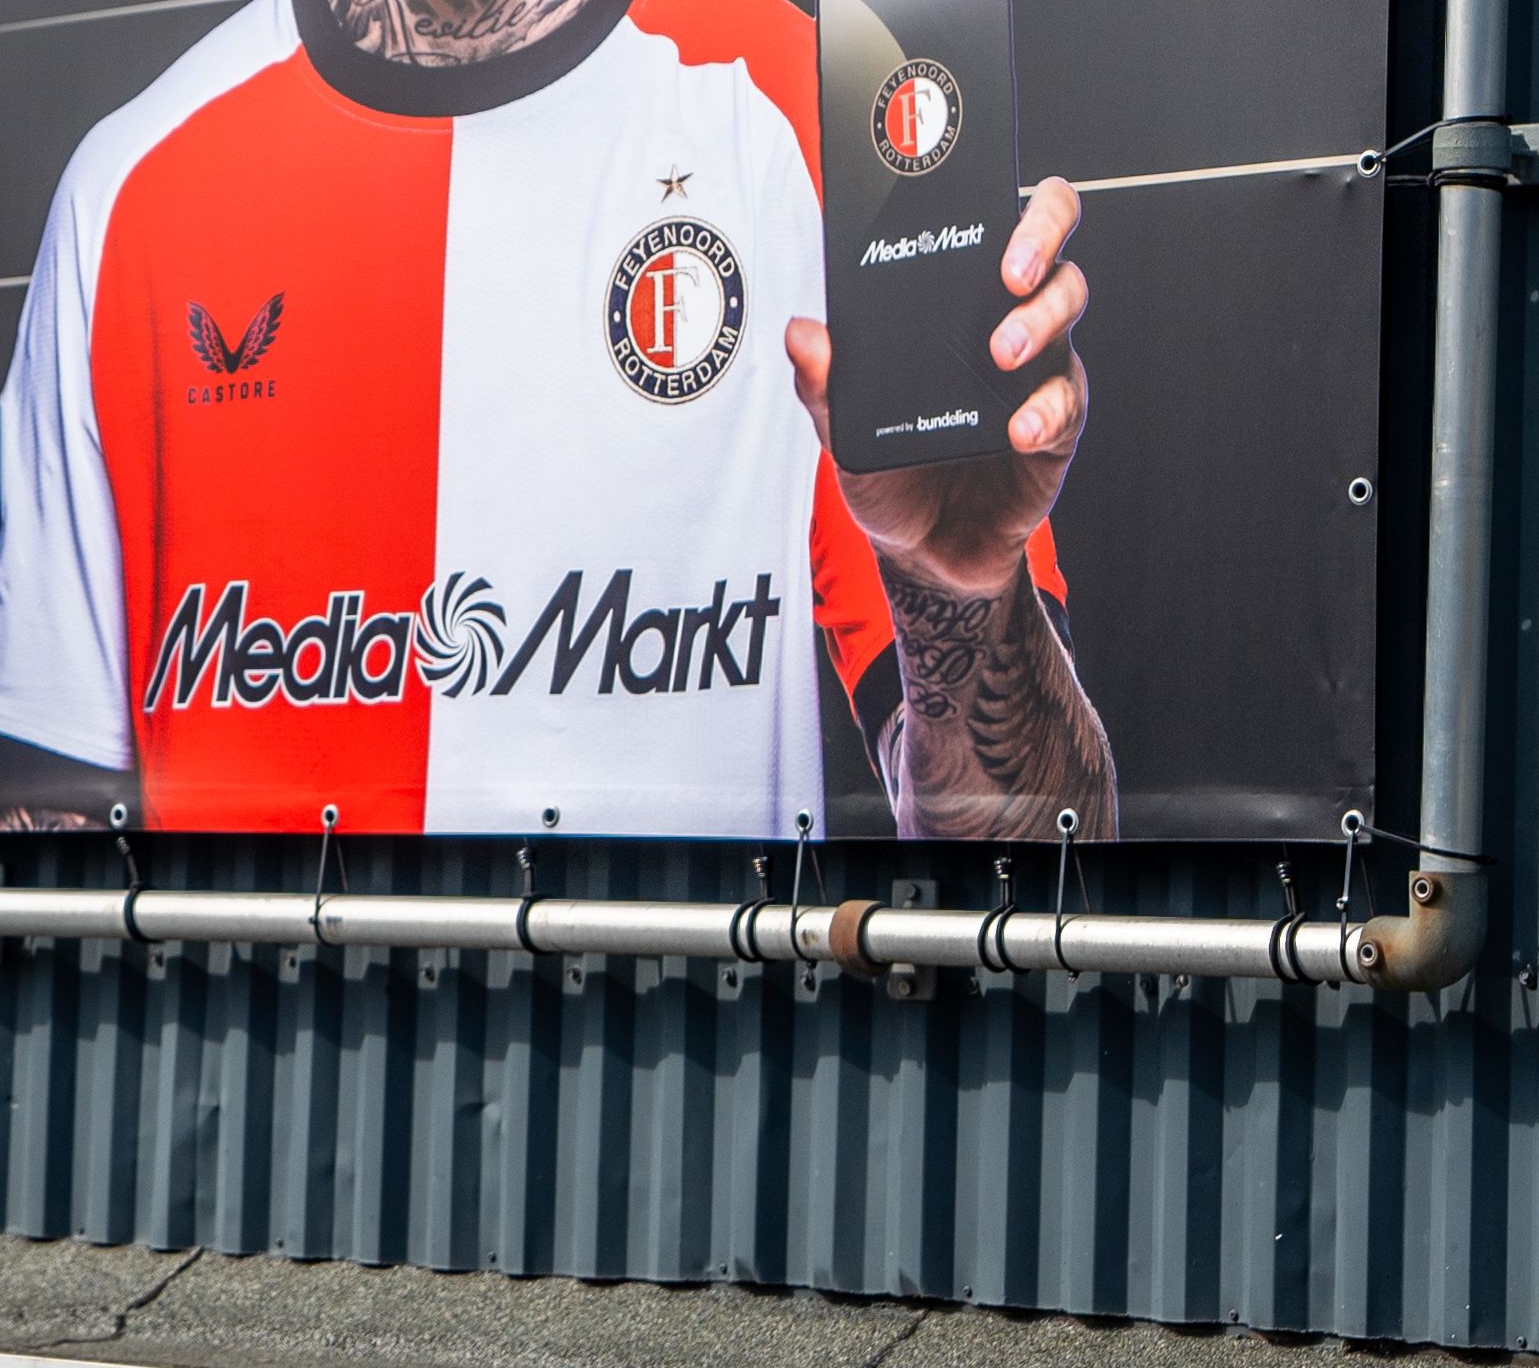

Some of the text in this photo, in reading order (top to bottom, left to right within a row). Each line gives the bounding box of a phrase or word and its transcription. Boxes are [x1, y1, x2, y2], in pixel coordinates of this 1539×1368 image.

[878, 62, 953, 109] FEYENOORD
[878, 124, 957, 172] ROTTERDAM
[614, 224, 736, 291] FEYENOORD
[614, 326, 739, 396] ROTTERDAM
[187, 379, 276, 404] CASTORE
[916, 408, 979, 432] bundeling
[143, 580, 418, 713] Media
[488, 568, 781, 697] Markt
